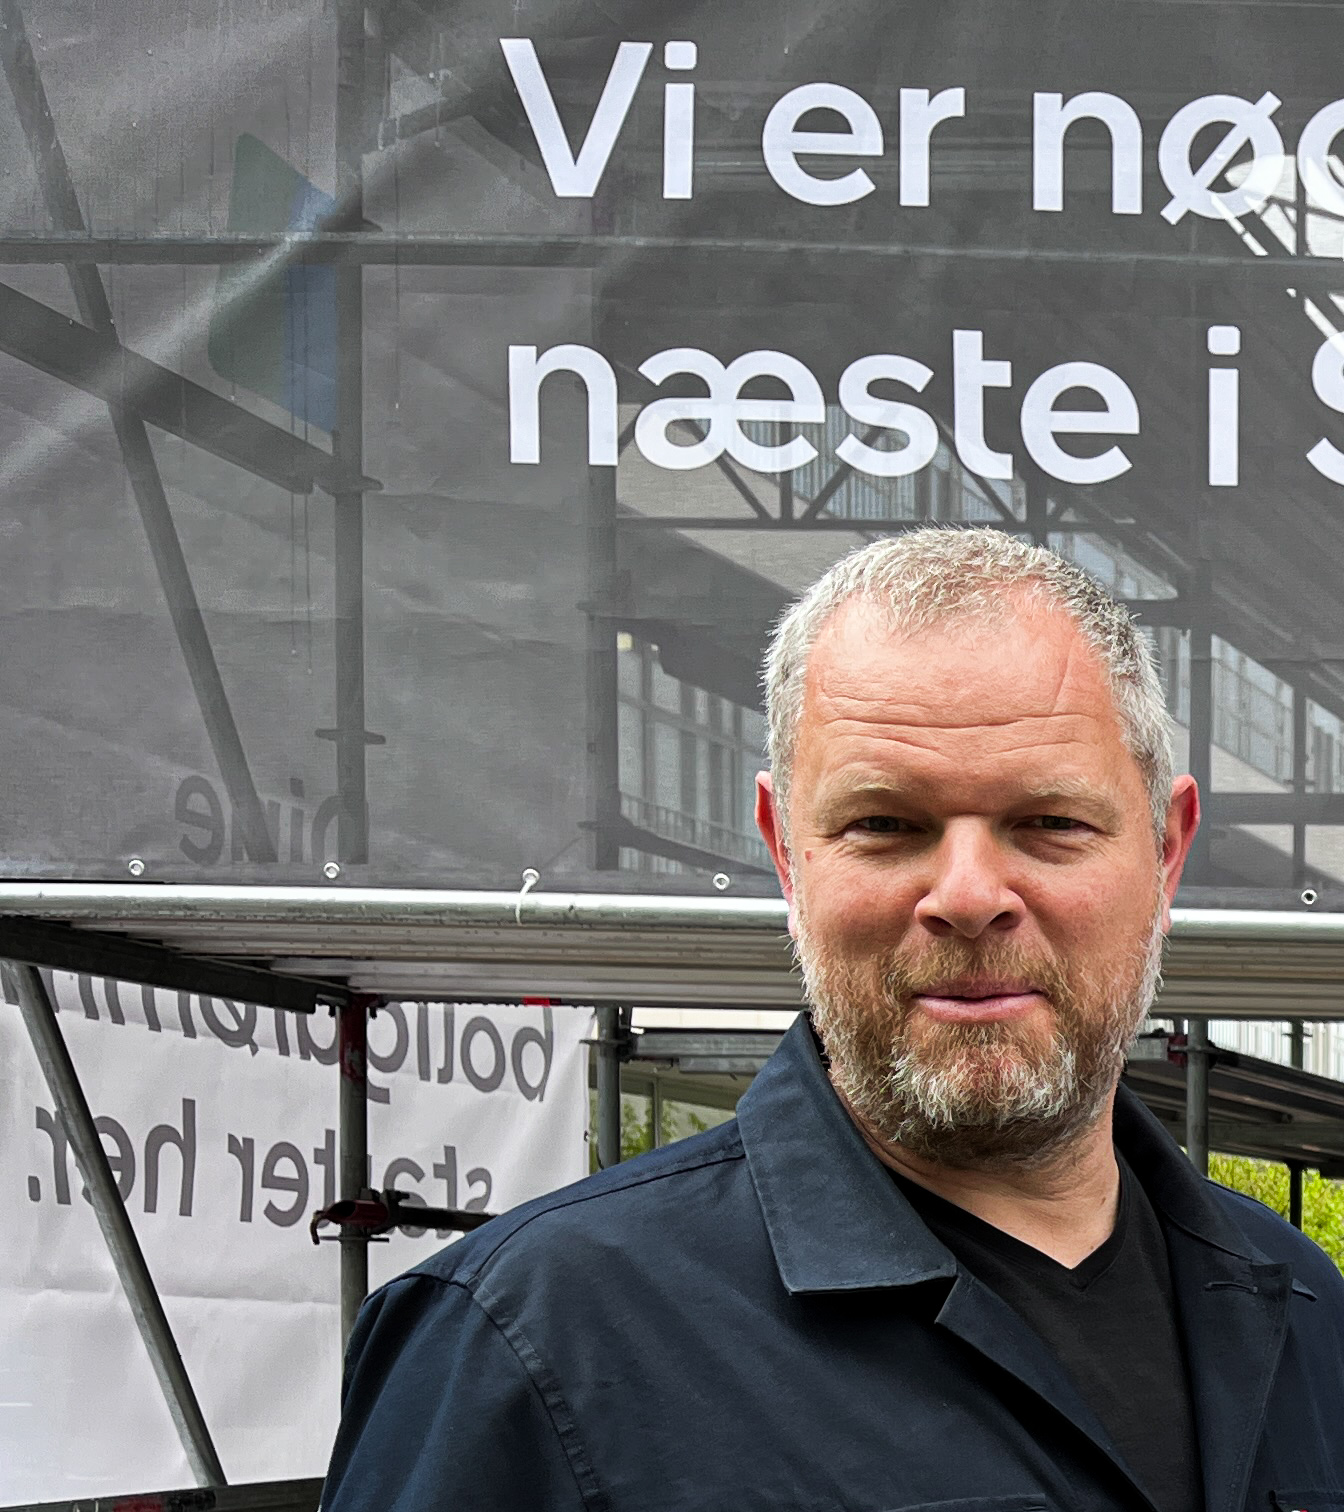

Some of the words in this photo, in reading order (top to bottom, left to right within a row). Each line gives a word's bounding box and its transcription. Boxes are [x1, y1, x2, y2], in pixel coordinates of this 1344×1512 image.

[499, 37, 698, 200] Vi
[761, 81, 966, 206] er
[507, 327, 1141, 485] næste
[1207, 324, 1241, 487] i
